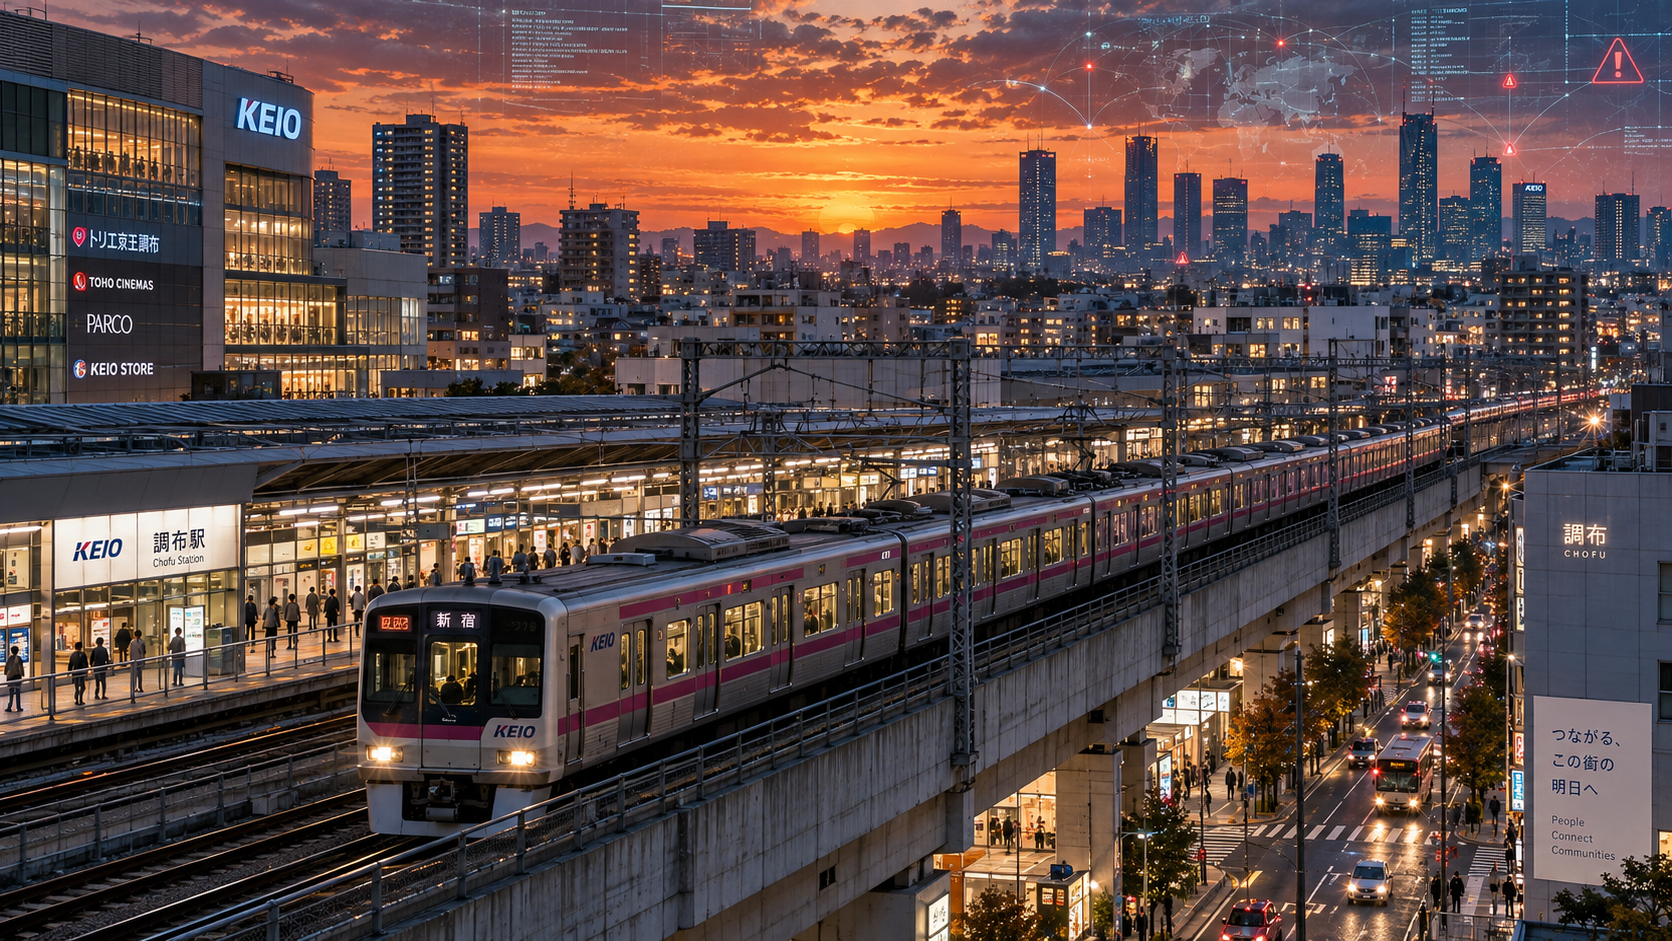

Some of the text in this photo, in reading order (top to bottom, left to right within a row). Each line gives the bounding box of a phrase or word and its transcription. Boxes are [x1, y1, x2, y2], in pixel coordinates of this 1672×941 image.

[237, 97, 301, 140] KEIO
[89, 276, 154, 290] TOHO CINEMAS
[86, 313, 133, 334] PARCO
[90, 362, 154, 376] KEIO STORE
[153, 528, 206, 554] 調布駅
[1563, 523, 1607, 546] 調布
[72, 538, 123, 562] KEIO
[1564, 549, 1606, 559] CHOFU
[153, 554, 205, 568] Chofu Station
[590, 631, 616, 653] KEIO
[493, 724, 536, 739] KEIO
[1552, 728, 1620, 747] つながる、
[1552, 753, 1615, 772] この街の
[1552, 779, 1598, 796] 明日へ
[1551, 815, 1585, 828] People
[1551, 830, 1593, 844] Connect
[1551, 845, 1616, 861] Communities
